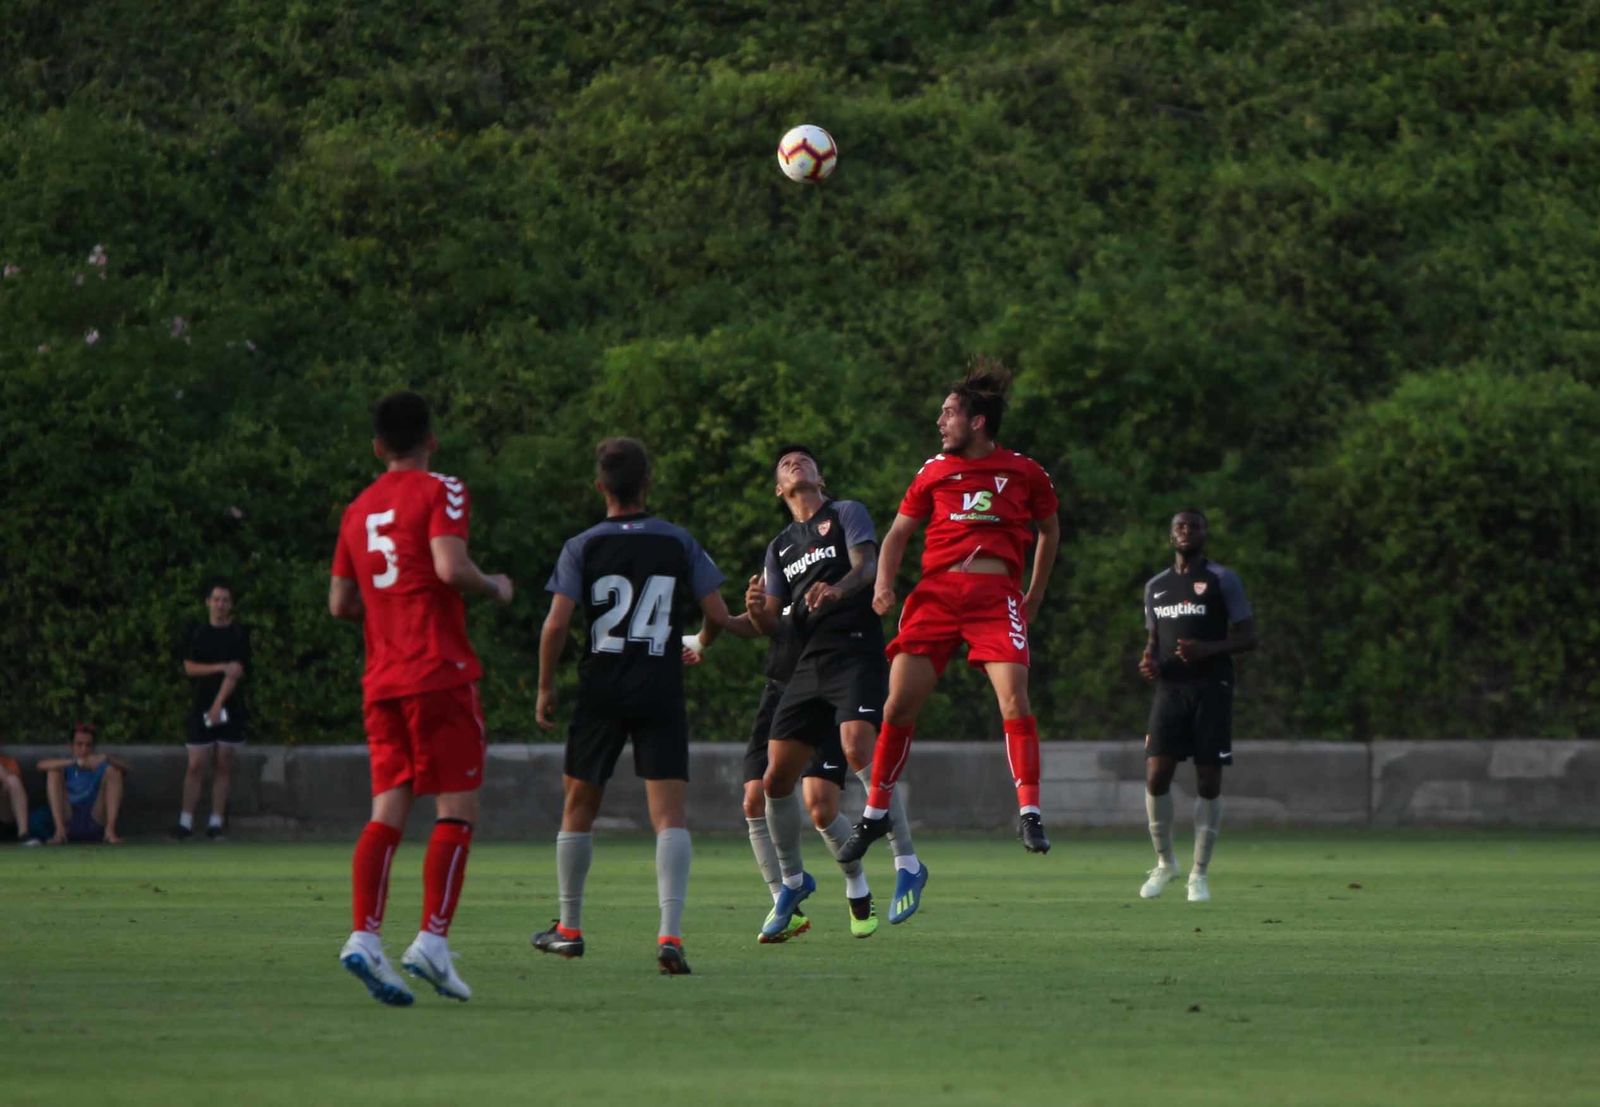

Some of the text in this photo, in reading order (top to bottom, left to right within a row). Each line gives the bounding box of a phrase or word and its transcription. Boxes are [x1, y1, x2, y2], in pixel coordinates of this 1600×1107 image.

[963, 491, 993, 512] VS
[366, 508, 398, 589] 5
[591, 574, 676, 656] 24
